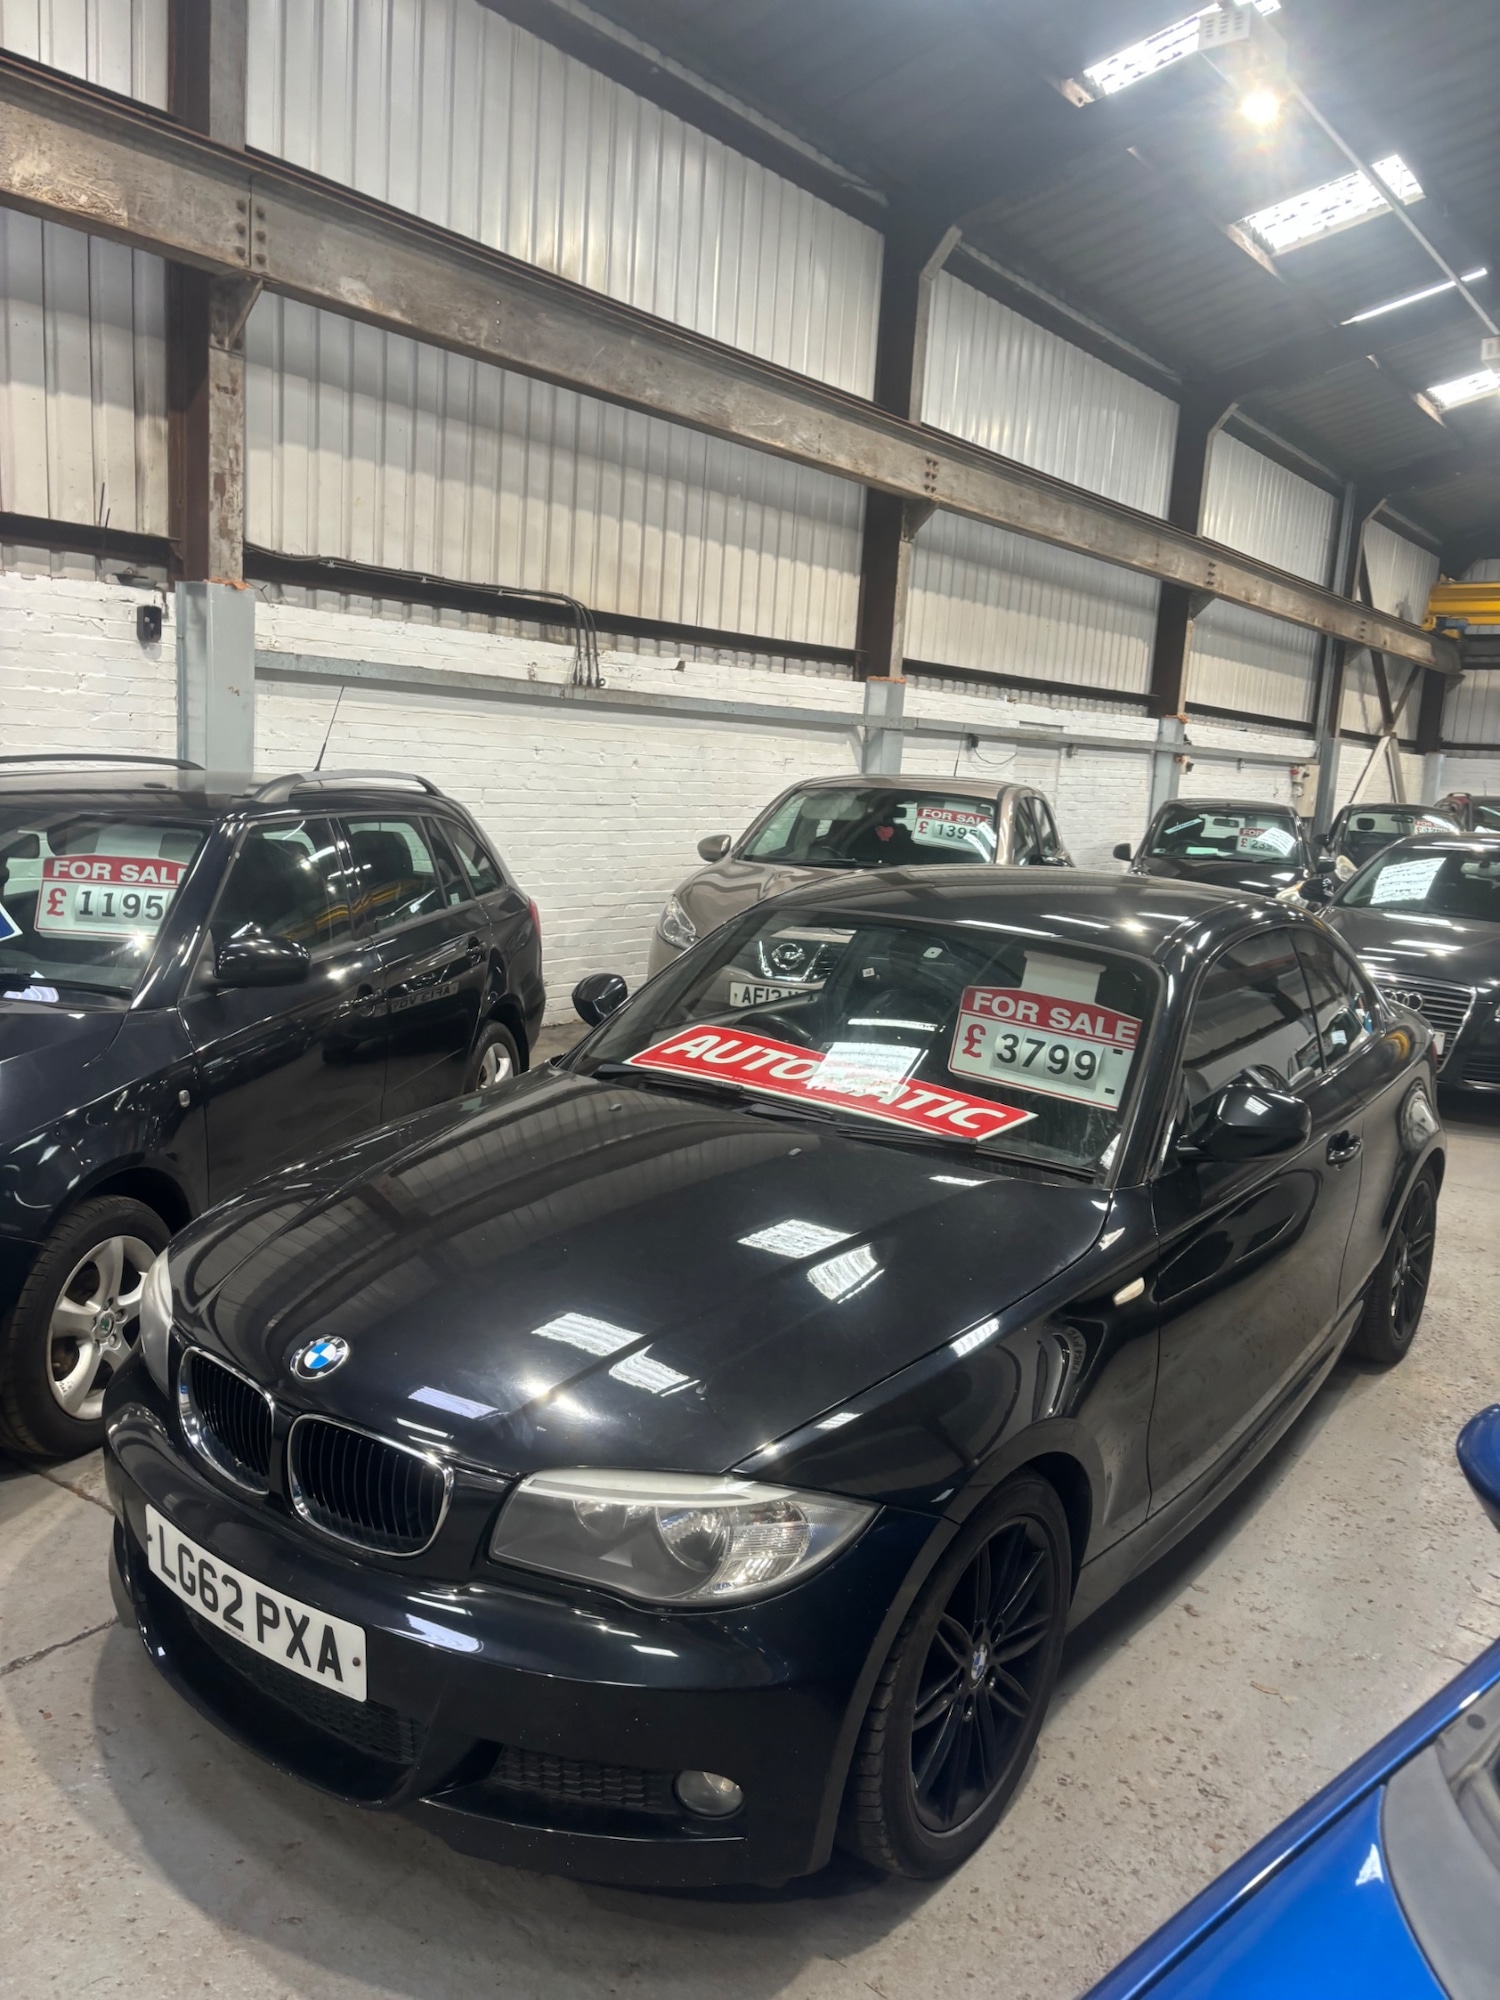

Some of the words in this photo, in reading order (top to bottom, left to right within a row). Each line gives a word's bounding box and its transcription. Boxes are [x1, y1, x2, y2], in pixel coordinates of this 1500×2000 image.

[918, 821, 928, 834] £
[922, 809, 952, 820] FOR
[52, 860, 112, 880] FOR
[46, 887, 67, 917] £
[79, 890, 164, 920] 1195
[972, 991, 1040, 1023] FOR
[1048, 1007, 1138, 1044] SALE
[962, 1024, 987, 1058] £
[996, 1033, 1097, 1081] 3799
[159, 1524, 244, 1632] LG62
[256, 1592, 344, 1682] PXA
